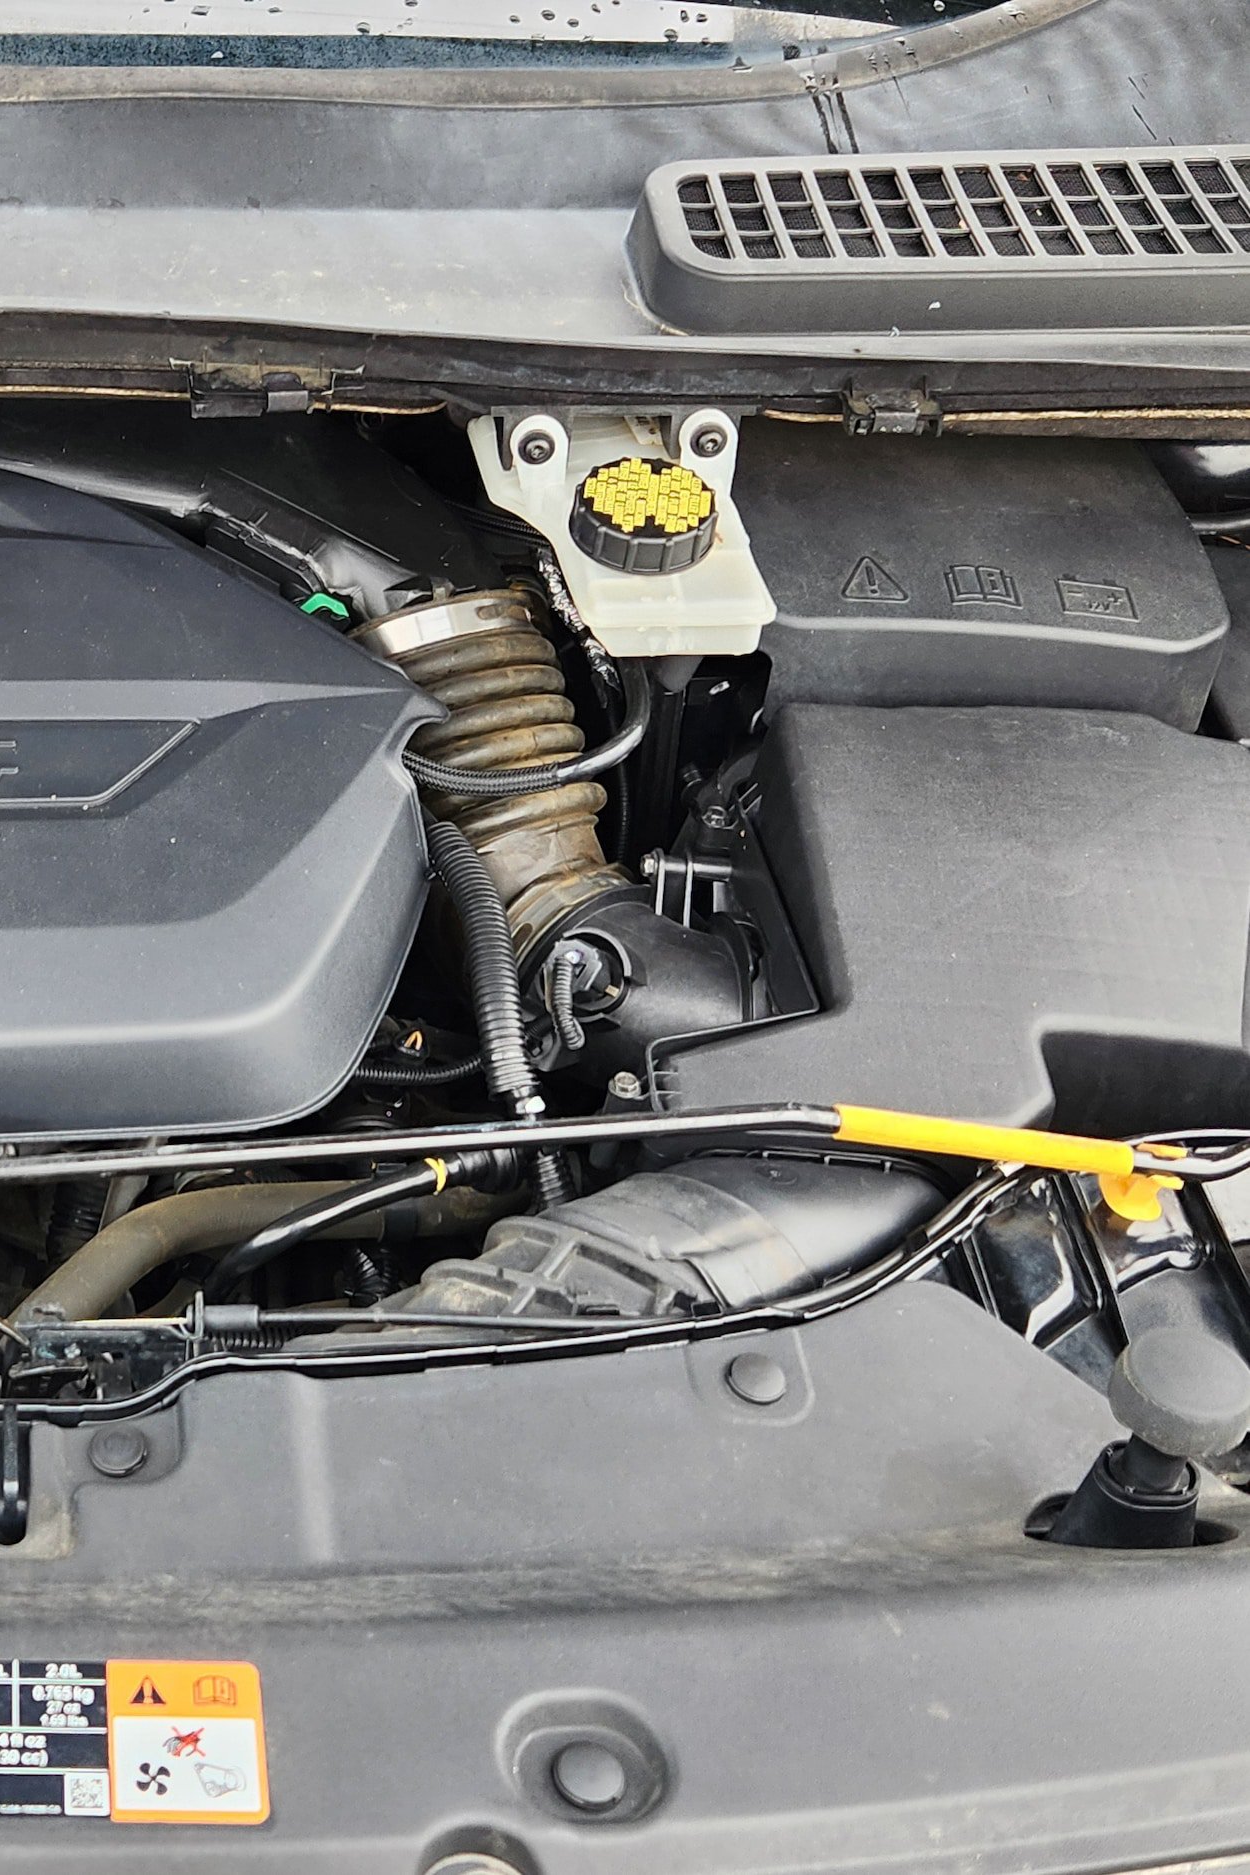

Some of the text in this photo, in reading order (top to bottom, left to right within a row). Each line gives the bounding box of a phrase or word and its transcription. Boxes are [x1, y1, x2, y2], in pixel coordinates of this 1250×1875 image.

[45, 1663, 83, 1679] 2.0L
[73, 1685, 95, 1705] kg
[63, 1702, 82, 1715] oz
[24, 1735, 47, 1748] oz
